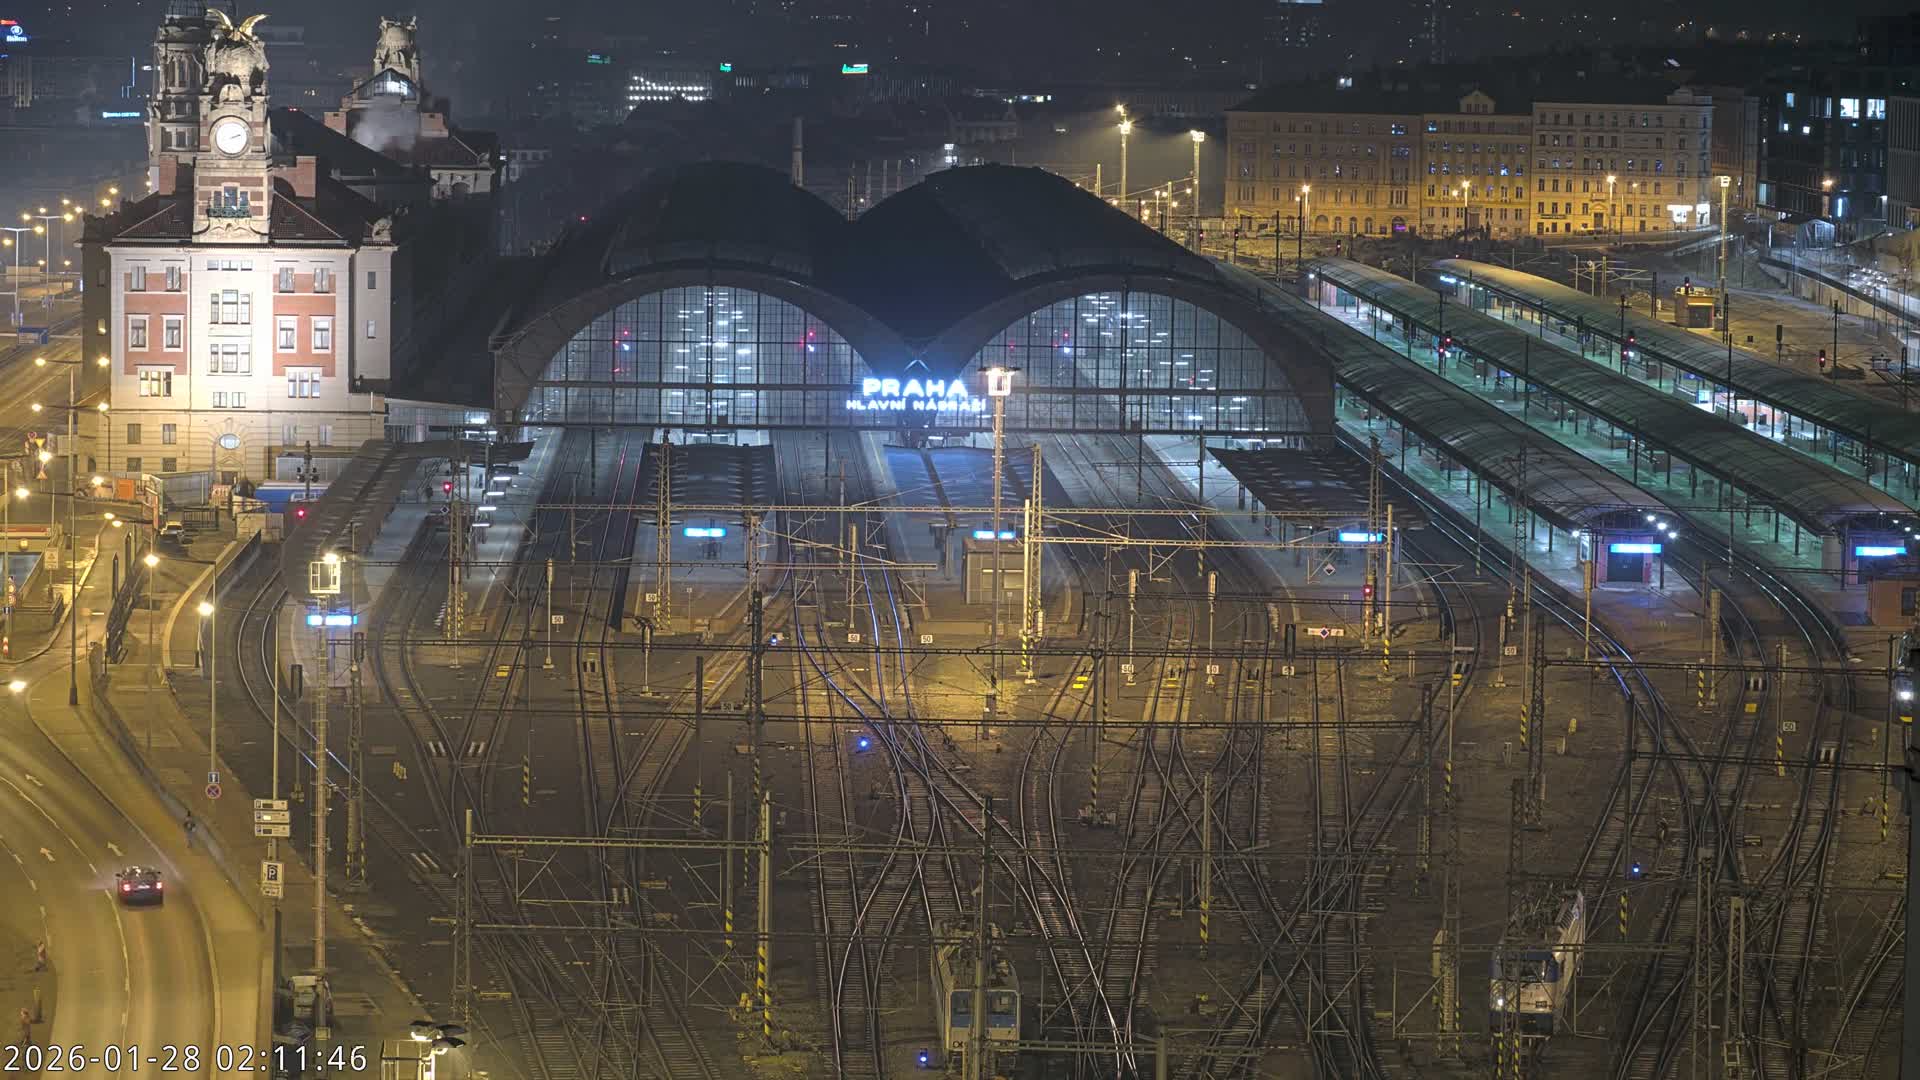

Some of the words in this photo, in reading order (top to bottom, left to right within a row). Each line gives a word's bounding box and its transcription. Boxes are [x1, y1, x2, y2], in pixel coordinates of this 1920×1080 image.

[863, 377, 969, 398] PRAHA
[846, 397, 906, 411] HLAVNÍ
[912, 397, 987, 412] NÁDRAŽÍ
[850, 634, 858, 642] 50
[1784, 722, 1793, 731] 50
